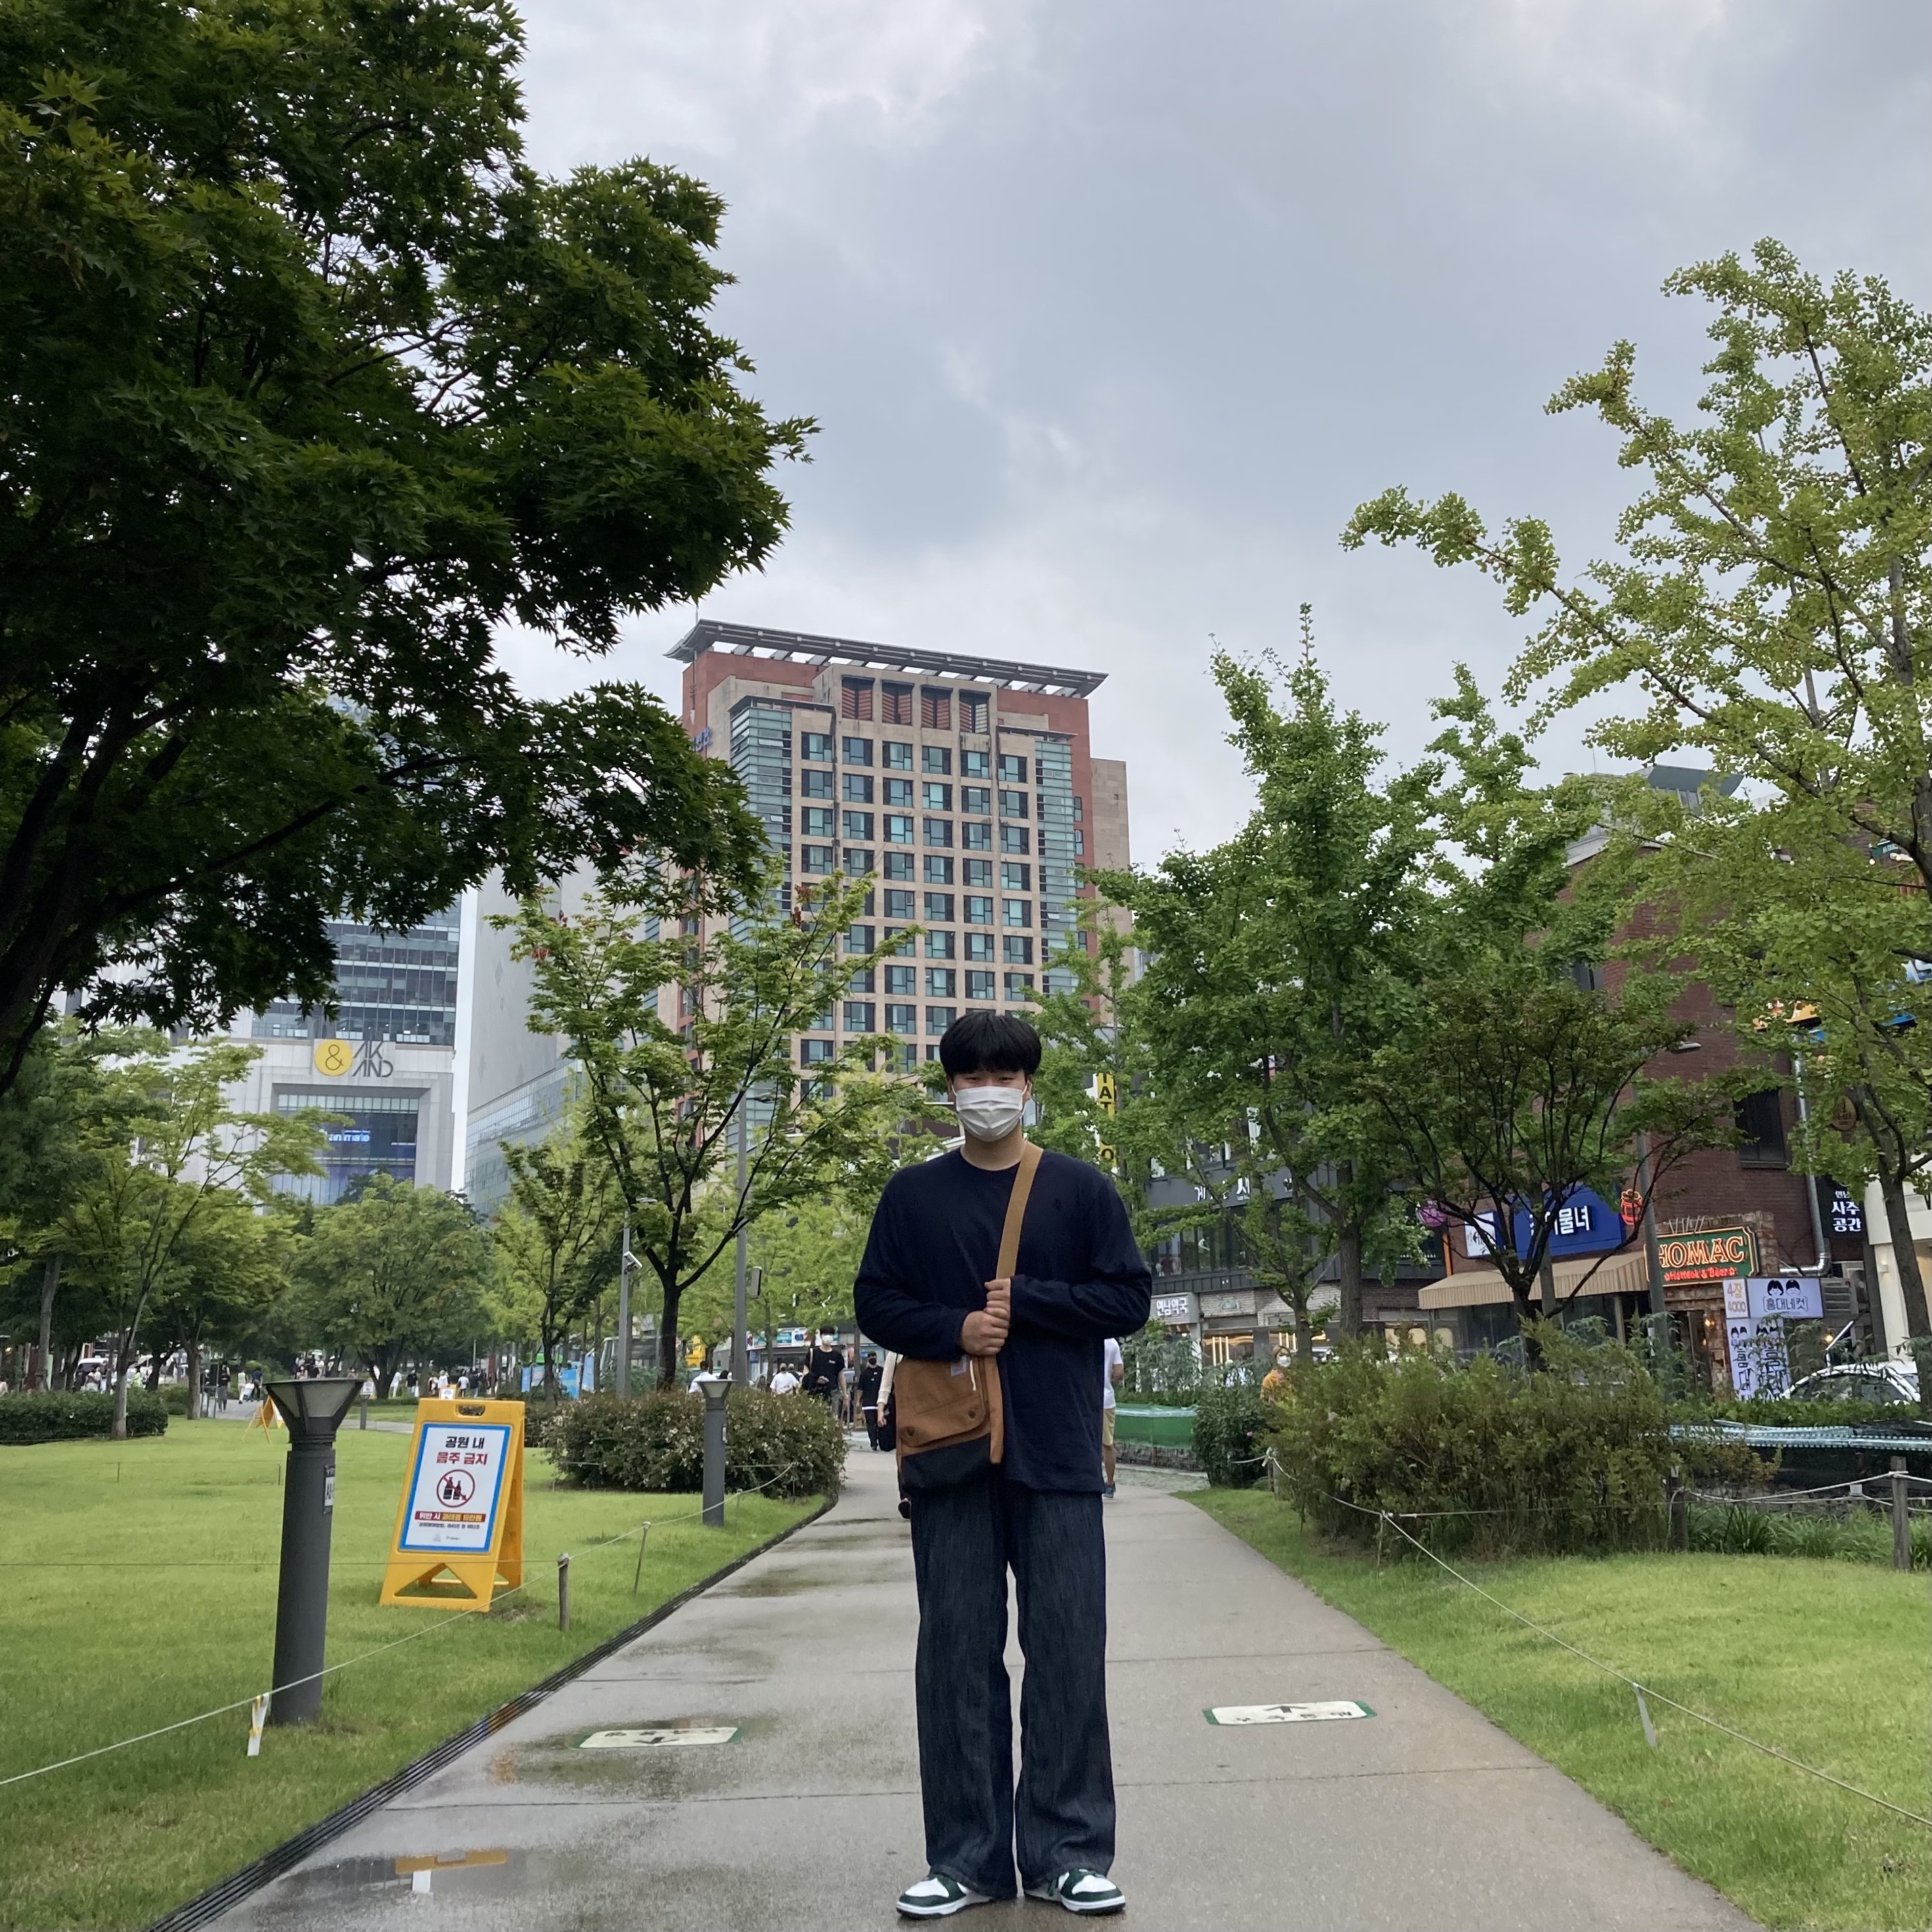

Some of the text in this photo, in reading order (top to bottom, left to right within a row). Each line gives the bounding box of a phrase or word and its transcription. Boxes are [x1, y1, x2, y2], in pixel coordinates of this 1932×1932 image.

[353, 1040, 384, 1059] AK
[353, 1059, 394, 1077] AND
[1831, 1201, 1860, 1215] 사주
[1833, 1217, 1862, 1232] 공간
[1727, 1283, 1743, 1299] 4장
[1156, 1297, 1188, 1316] 연남약국
[1728, 1301, 1746, 1313] 4000
[445, 1436, 485, 1449] 공원 내
[436, 1452, 488, 1465] 음주 금지
